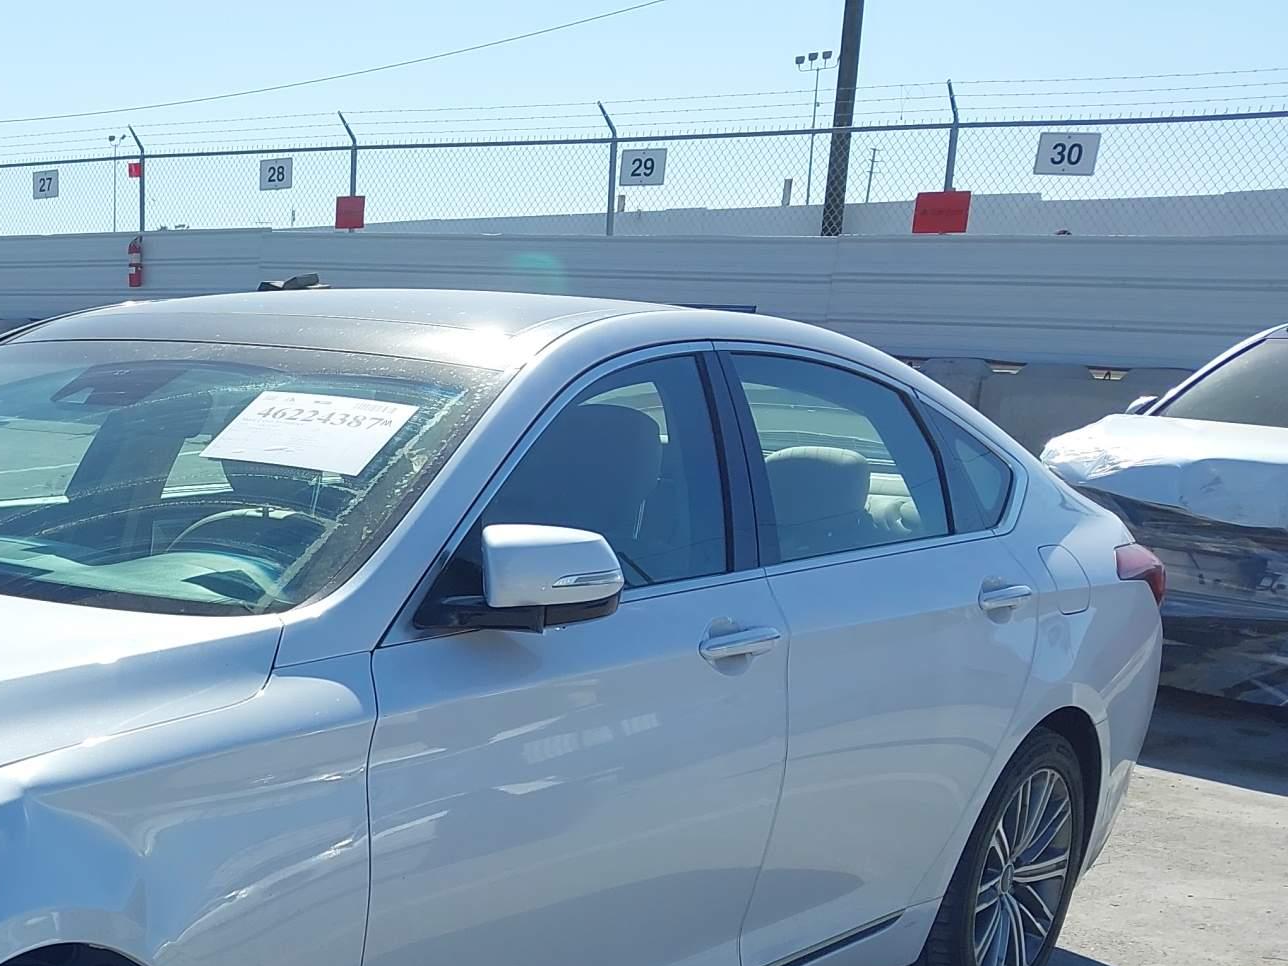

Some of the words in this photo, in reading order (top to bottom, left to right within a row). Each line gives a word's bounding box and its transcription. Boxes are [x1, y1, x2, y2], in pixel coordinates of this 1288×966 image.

[1050, 142, 1083, 165] 30
[267, 166, 285, 183] 28
[630, 157, 655, 177] 29
[38, 177, 52, 192] 27
[256, 406, 385, 430] 46224387
